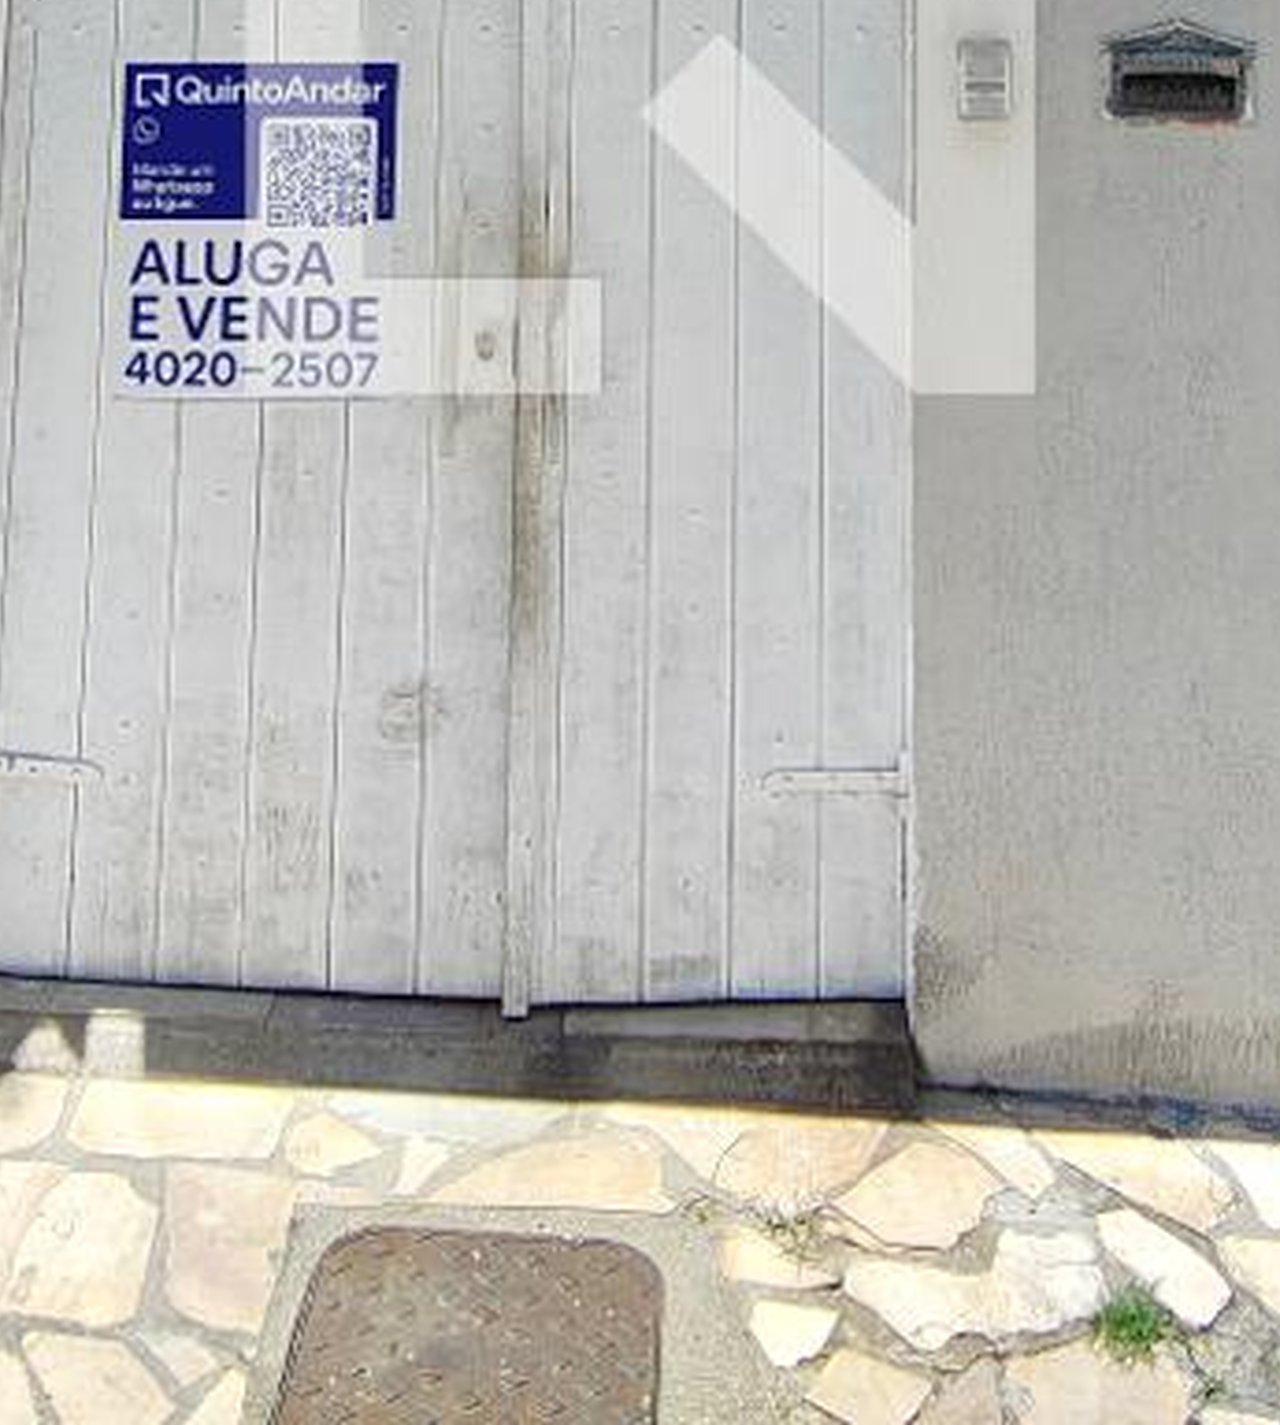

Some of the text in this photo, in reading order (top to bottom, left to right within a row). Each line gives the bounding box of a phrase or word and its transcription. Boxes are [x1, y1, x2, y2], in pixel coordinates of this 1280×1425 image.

[175, 76, 387, 105] QuintoAndar
[130, 240, 334, 285] ALUGA
[130, 296, 380, 342] E VENDE
[125, 352, 380, 387] 4020-2507
